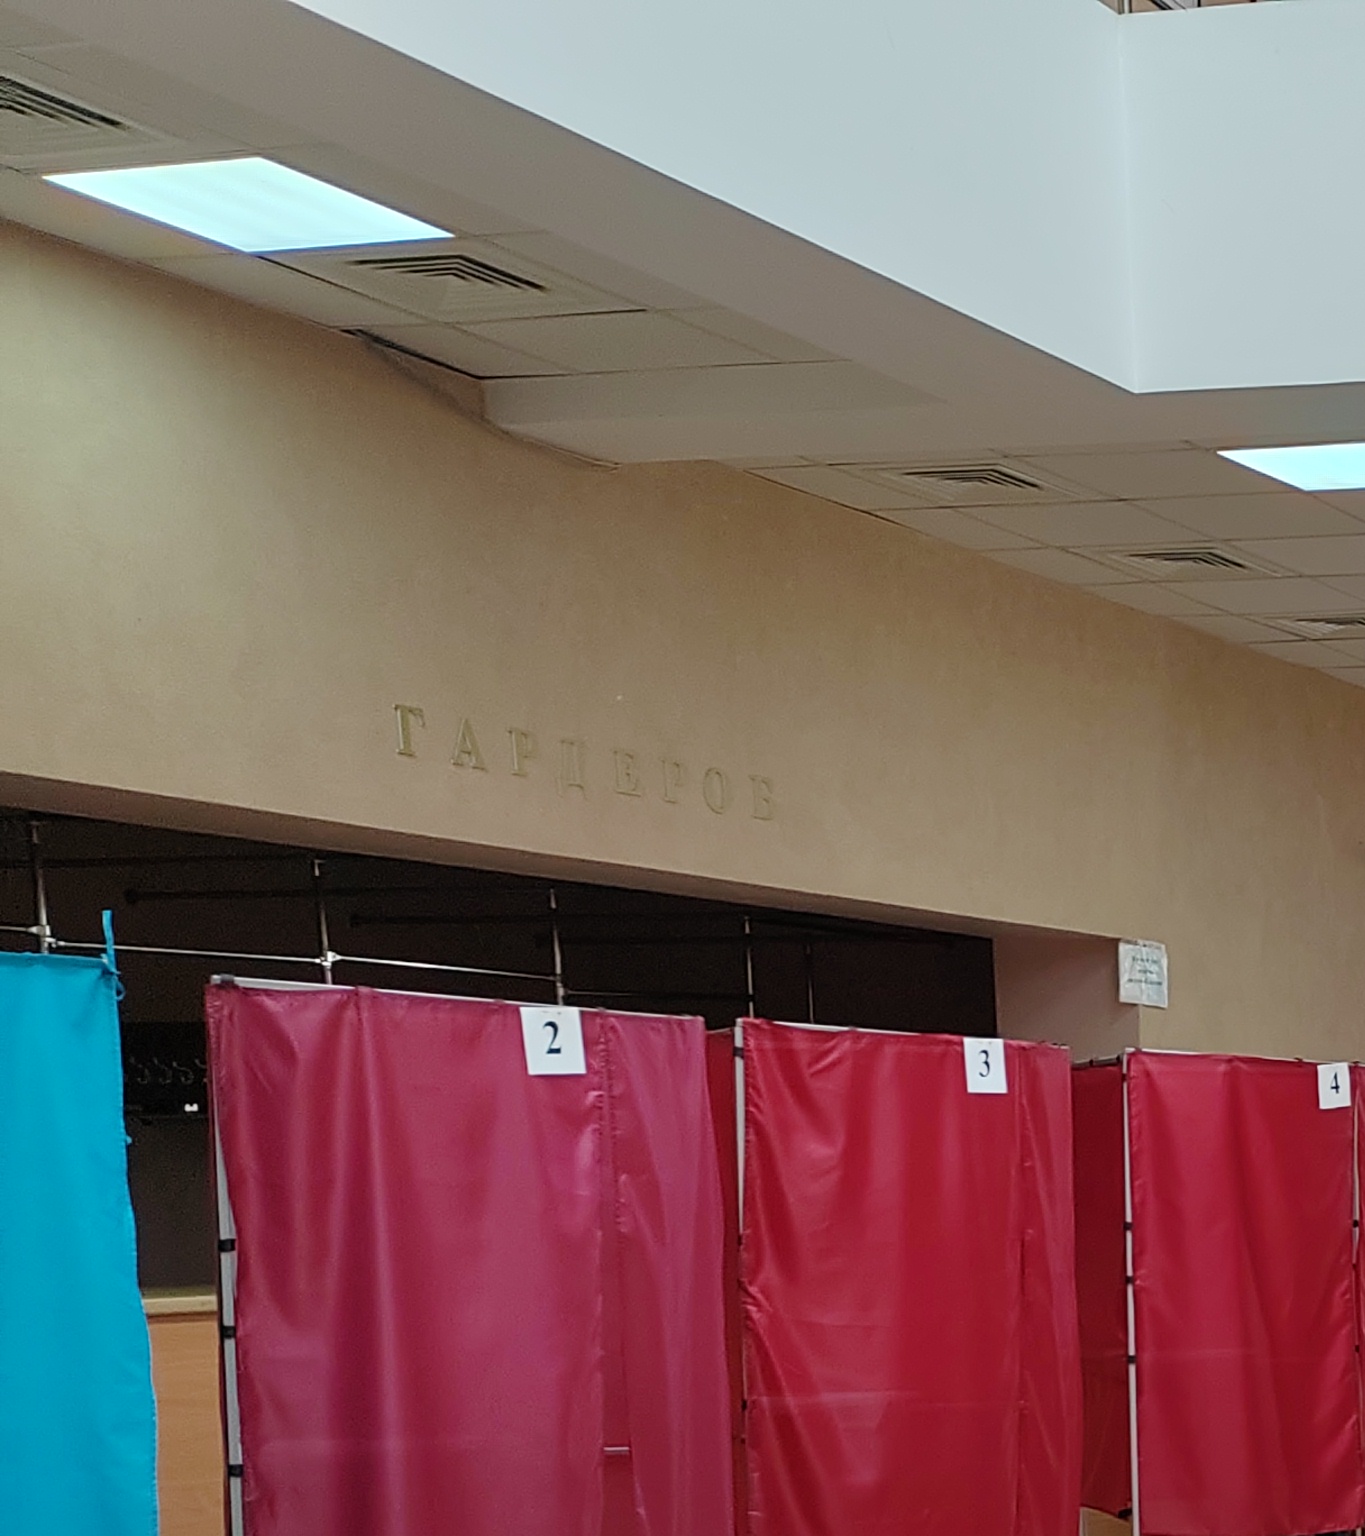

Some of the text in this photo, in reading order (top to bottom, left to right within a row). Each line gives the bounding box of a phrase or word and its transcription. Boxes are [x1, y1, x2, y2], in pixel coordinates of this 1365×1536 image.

[543, 1020, 564, 1056] 2
[977, 1049, 993, 1078] 3
[1330, 1072, 1341, 1094] 4
